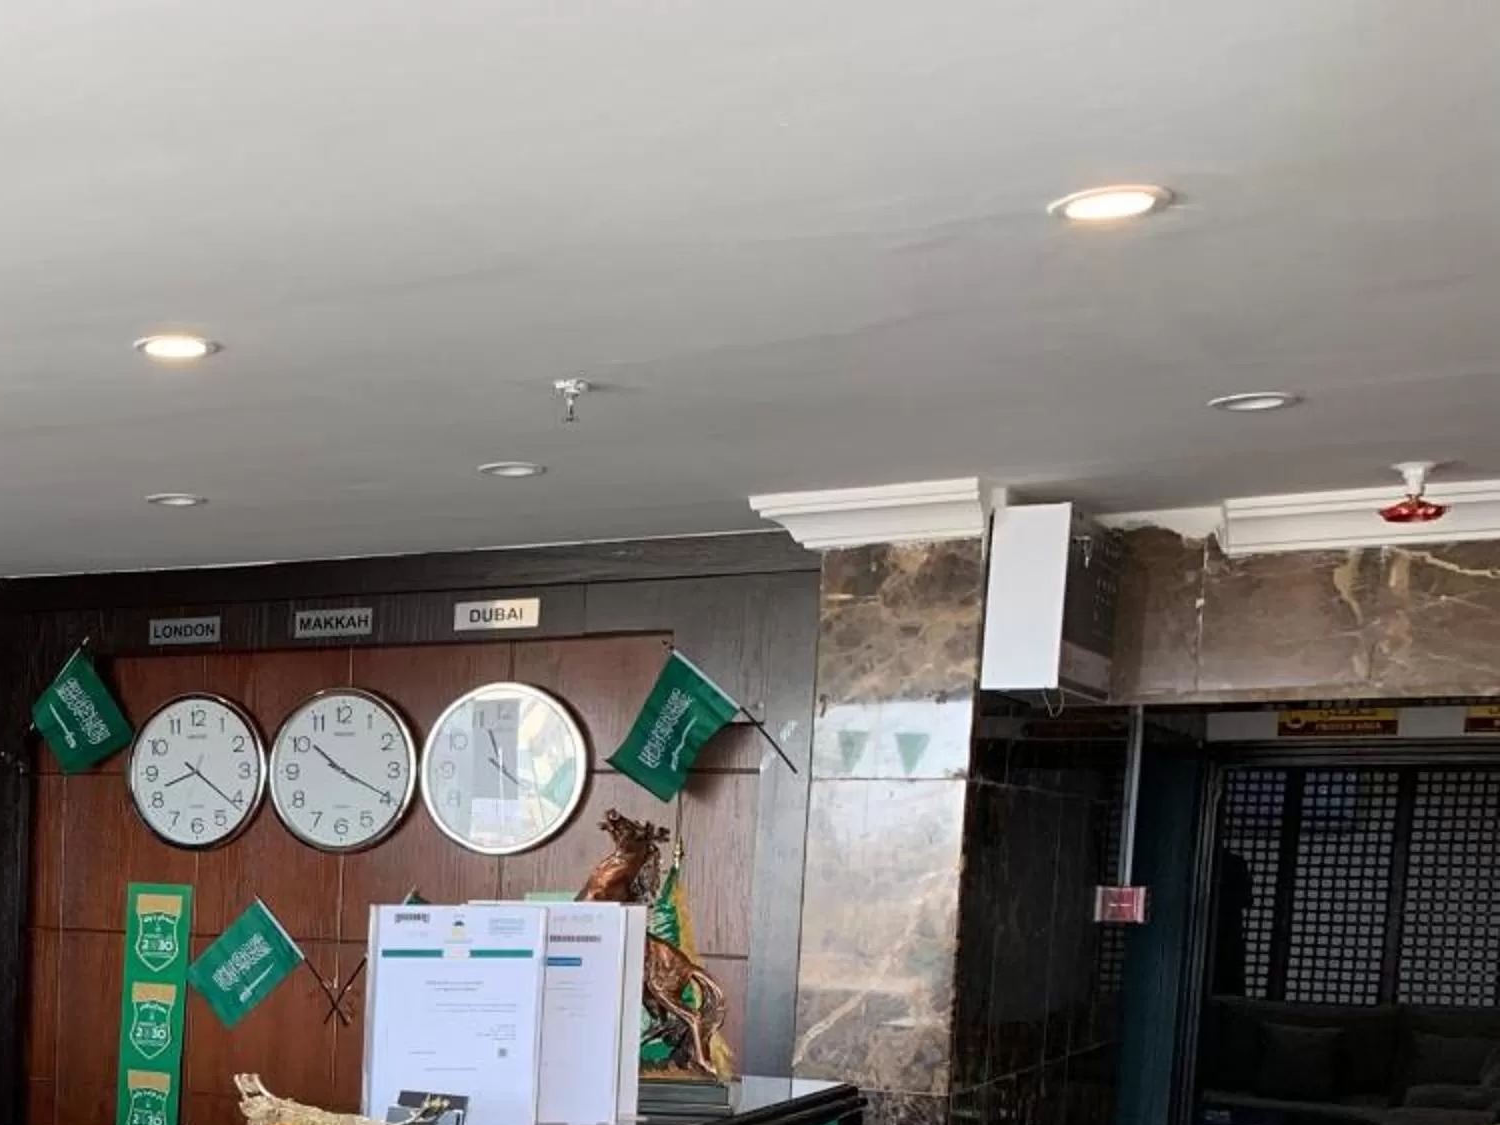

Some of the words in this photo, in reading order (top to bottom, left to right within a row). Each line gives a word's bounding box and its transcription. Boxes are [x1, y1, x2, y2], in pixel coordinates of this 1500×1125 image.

[299, 614, 370, 632] MAKKAH
[469, 606, 523, 623] DUBAI
[153, 622, 216, 639] LONDON
[191, 709, 207, 727] 12
[313, 714, 325, 733] 11
[336, 705, 353, 724] 12
[367, 713, 373, 730] 1
[169, 718, 181, 735] 11
[219, 717, 225, 734] 1
[149, 739, 169, 756] 10
[232, 735, 245, 753] 2
[292, 735, 311, 753] 10
[381, 732, 395, 751] 2
[145, 765, 159, 783] 9
[238, 762, 250, 780] 3
[285, 763, 300, 781] 9
[387, 761, 400, 779] 3
[151, 791, 164, 809] 8
[291, 790, 305, 809] 8
[168, 811, 181, 827] 7
[191, 817, 205, 834] 6
[214, 810, 228, 826] 5
[310, 811, 323, 828] 7
[333, 818, 349, 835] 6
[360, 811, 374, 828] 5
